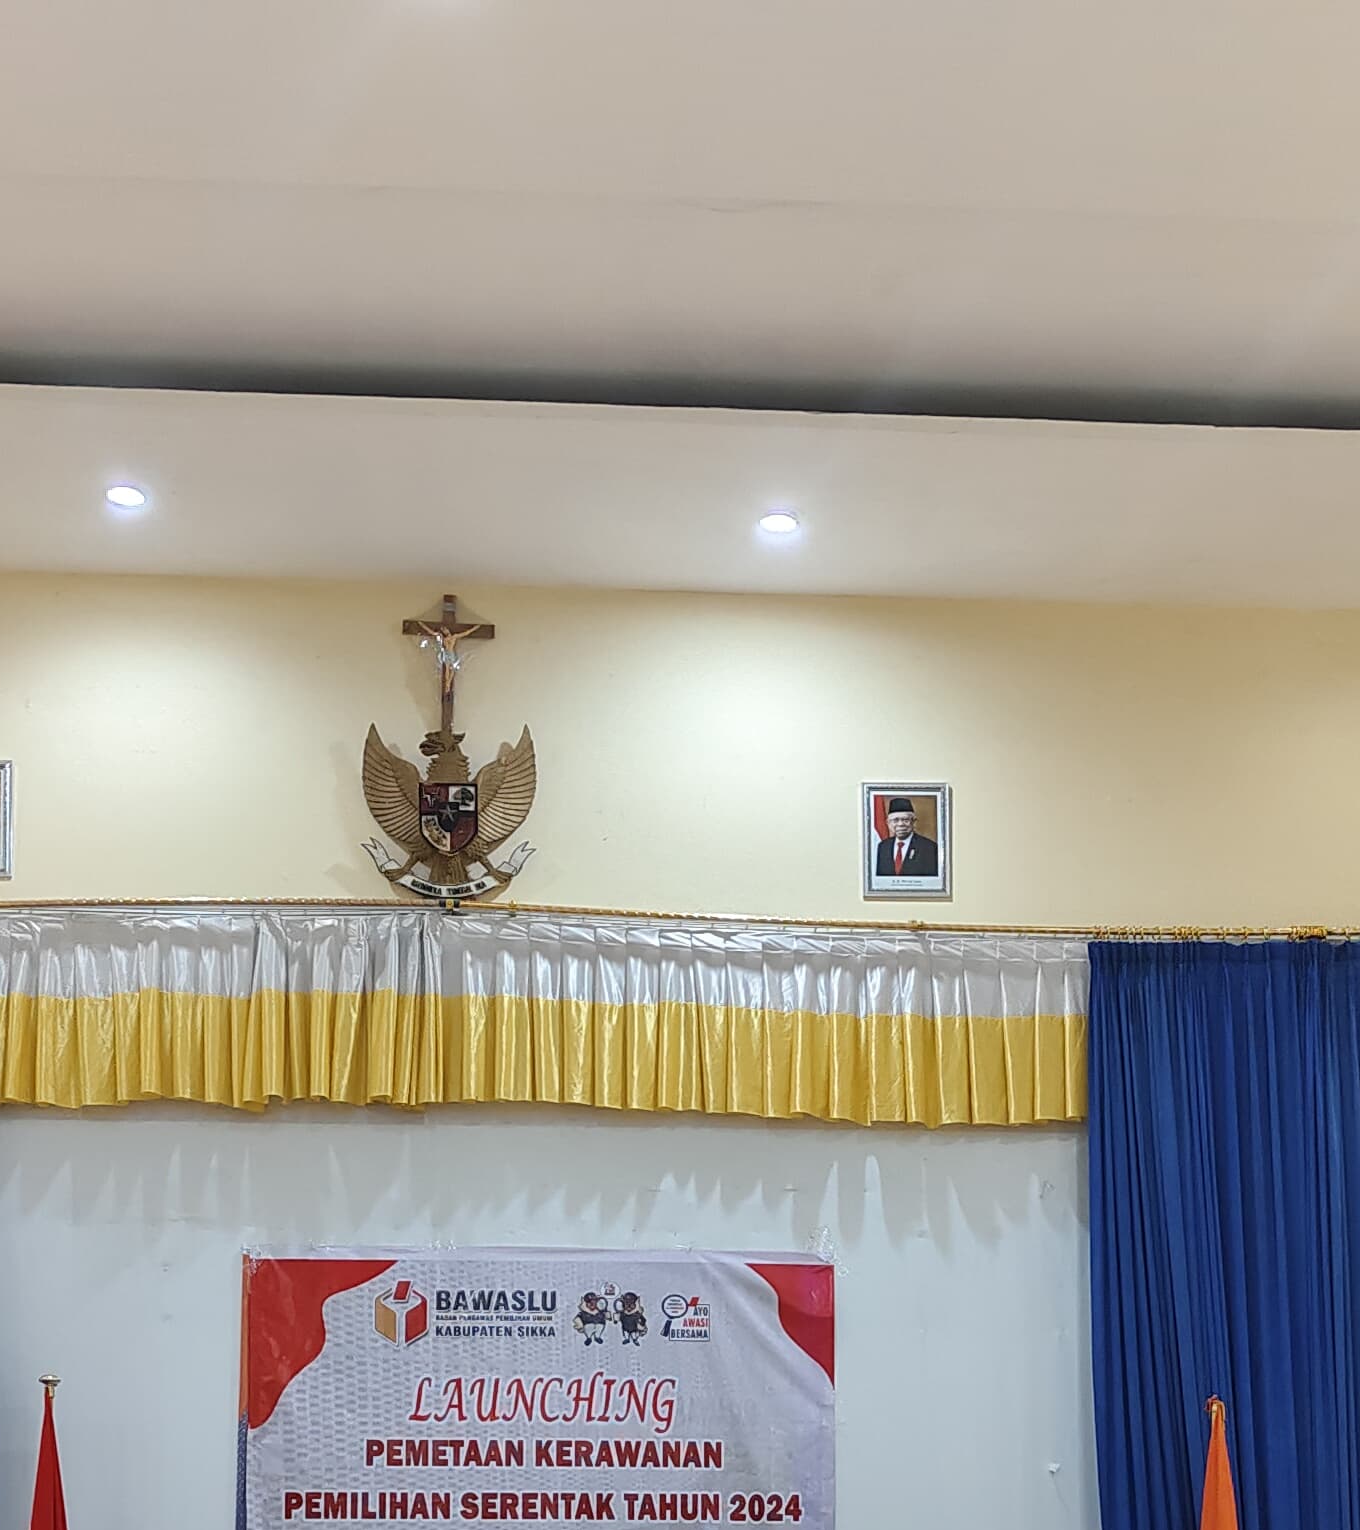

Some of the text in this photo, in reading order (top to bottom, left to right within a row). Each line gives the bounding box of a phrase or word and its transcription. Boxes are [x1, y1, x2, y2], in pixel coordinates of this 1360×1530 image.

[435, 1290, 557, 1311] BAWASLU
[693, 1307, 709, 1316] AYO
[682, 1318, 709, 1327] AWASI
[435, 1325, 556, 1338] KABUPATEN SIKKA
[670, 1329, 709, 1339] BERSAMA
[408, 1372, 677, 1433] LAUNCHING
[366, 1440, 723, 1468] PEMETAAN KERAWANAN
[284, 1493, 803, 1522] PEMILIHAN SERENTAK TAHUN 2024
